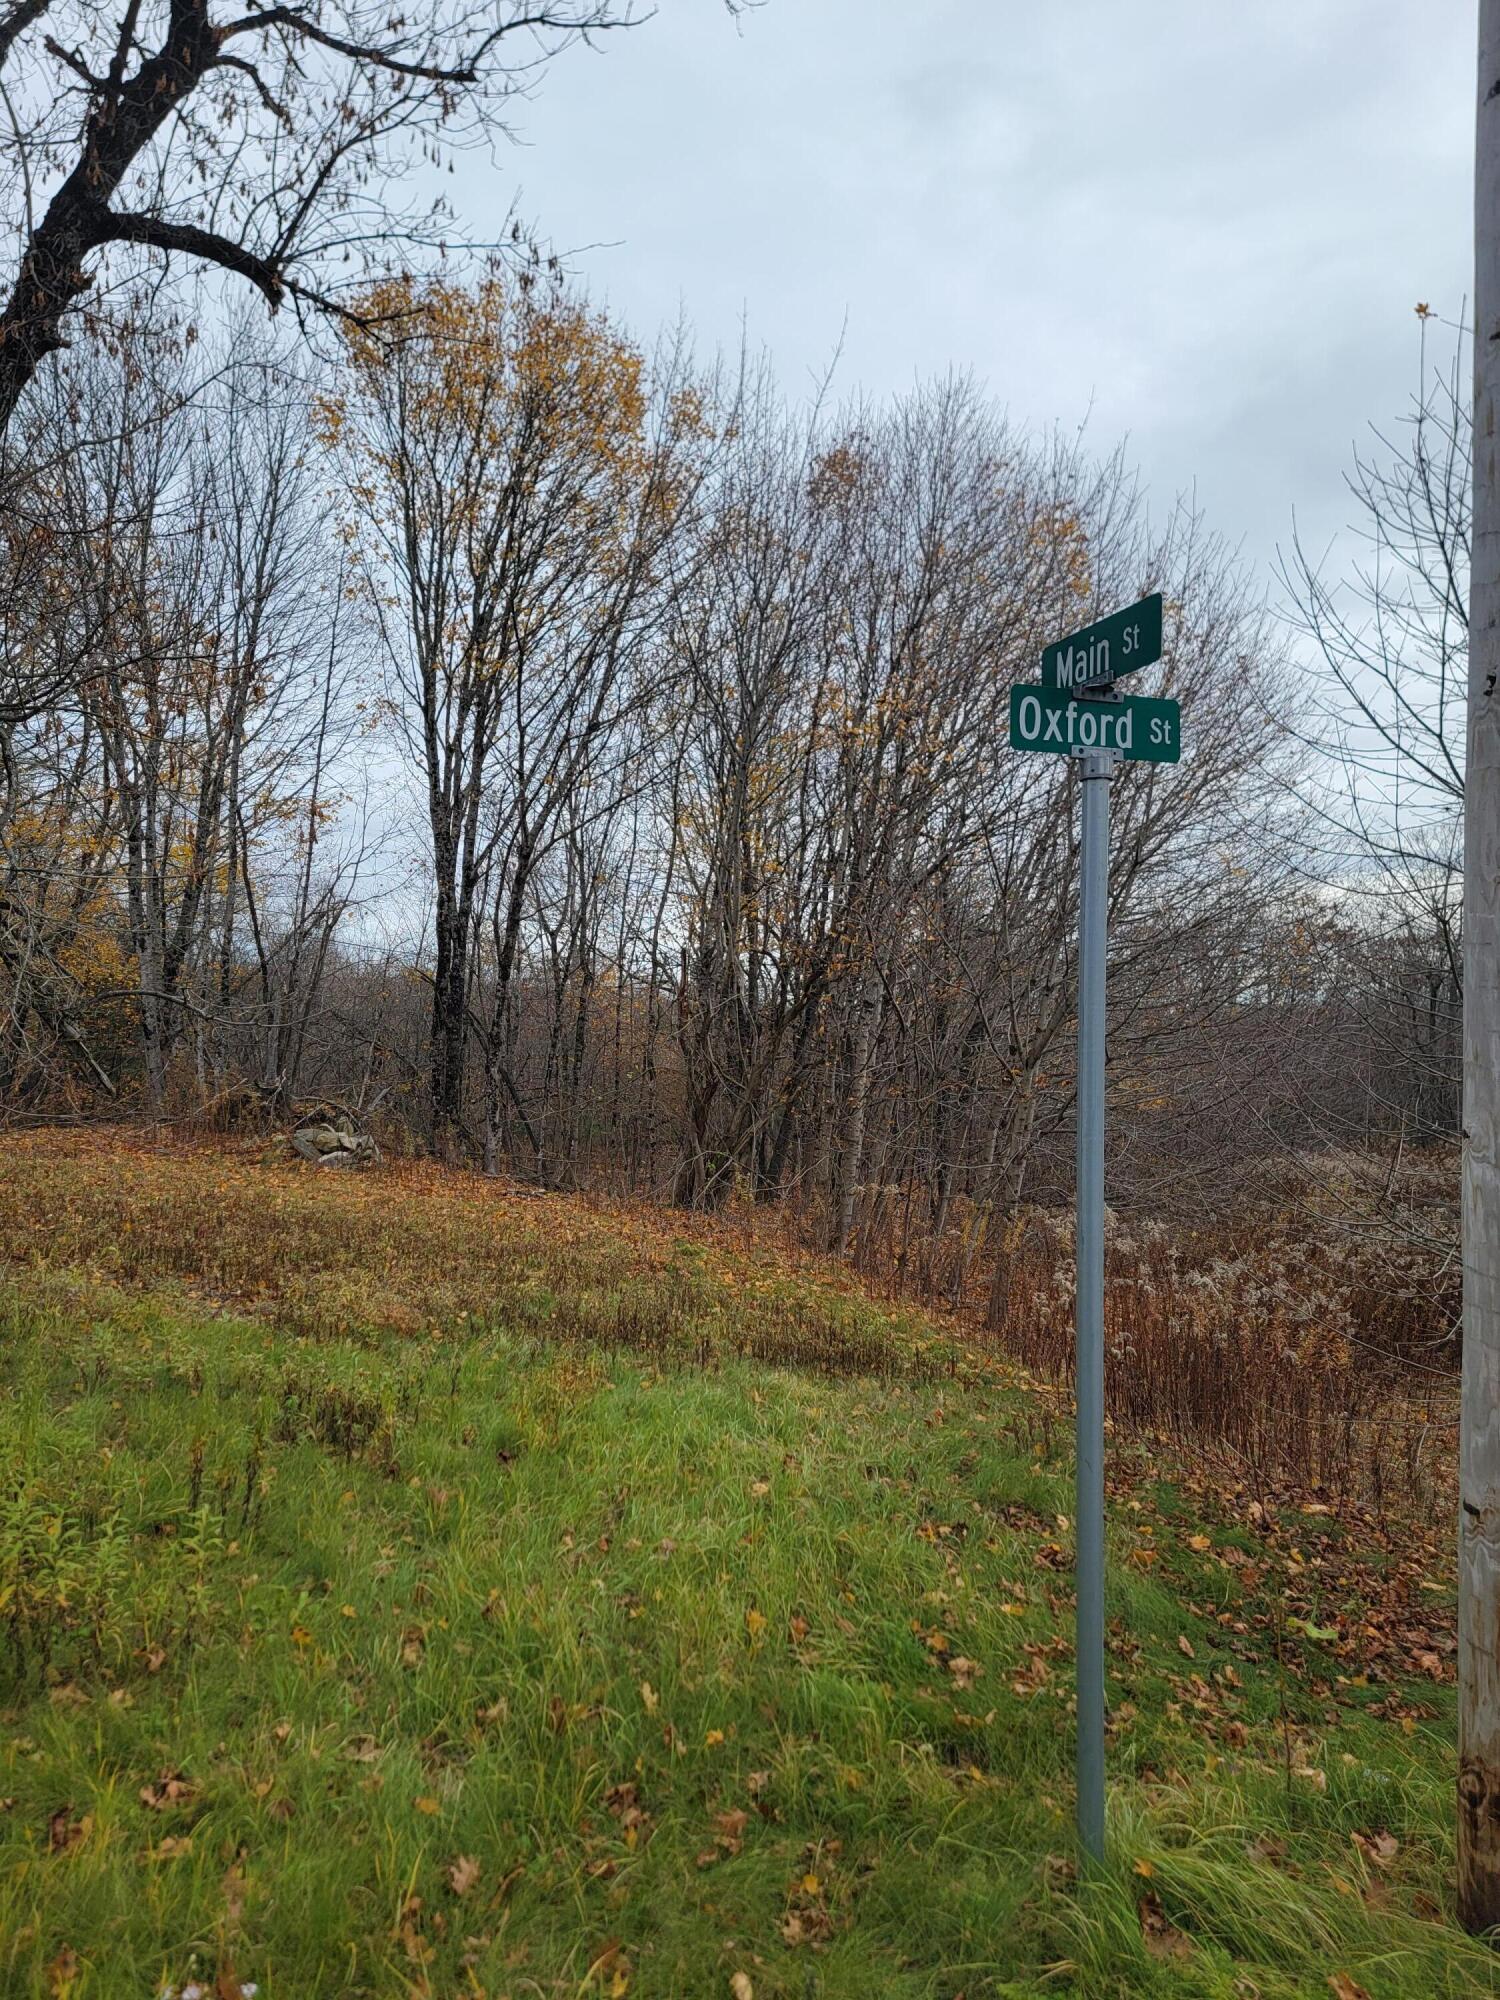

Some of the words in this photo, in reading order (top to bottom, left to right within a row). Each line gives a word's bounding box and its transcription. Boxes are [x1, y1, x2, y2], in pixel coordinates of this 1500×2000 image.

[1056, 636, 1110, 688] Main
[1122, 624, 1140, 654] St
[1019, 695, 1132, 748] Oxford
[1150, 717, 1171, 744] St
